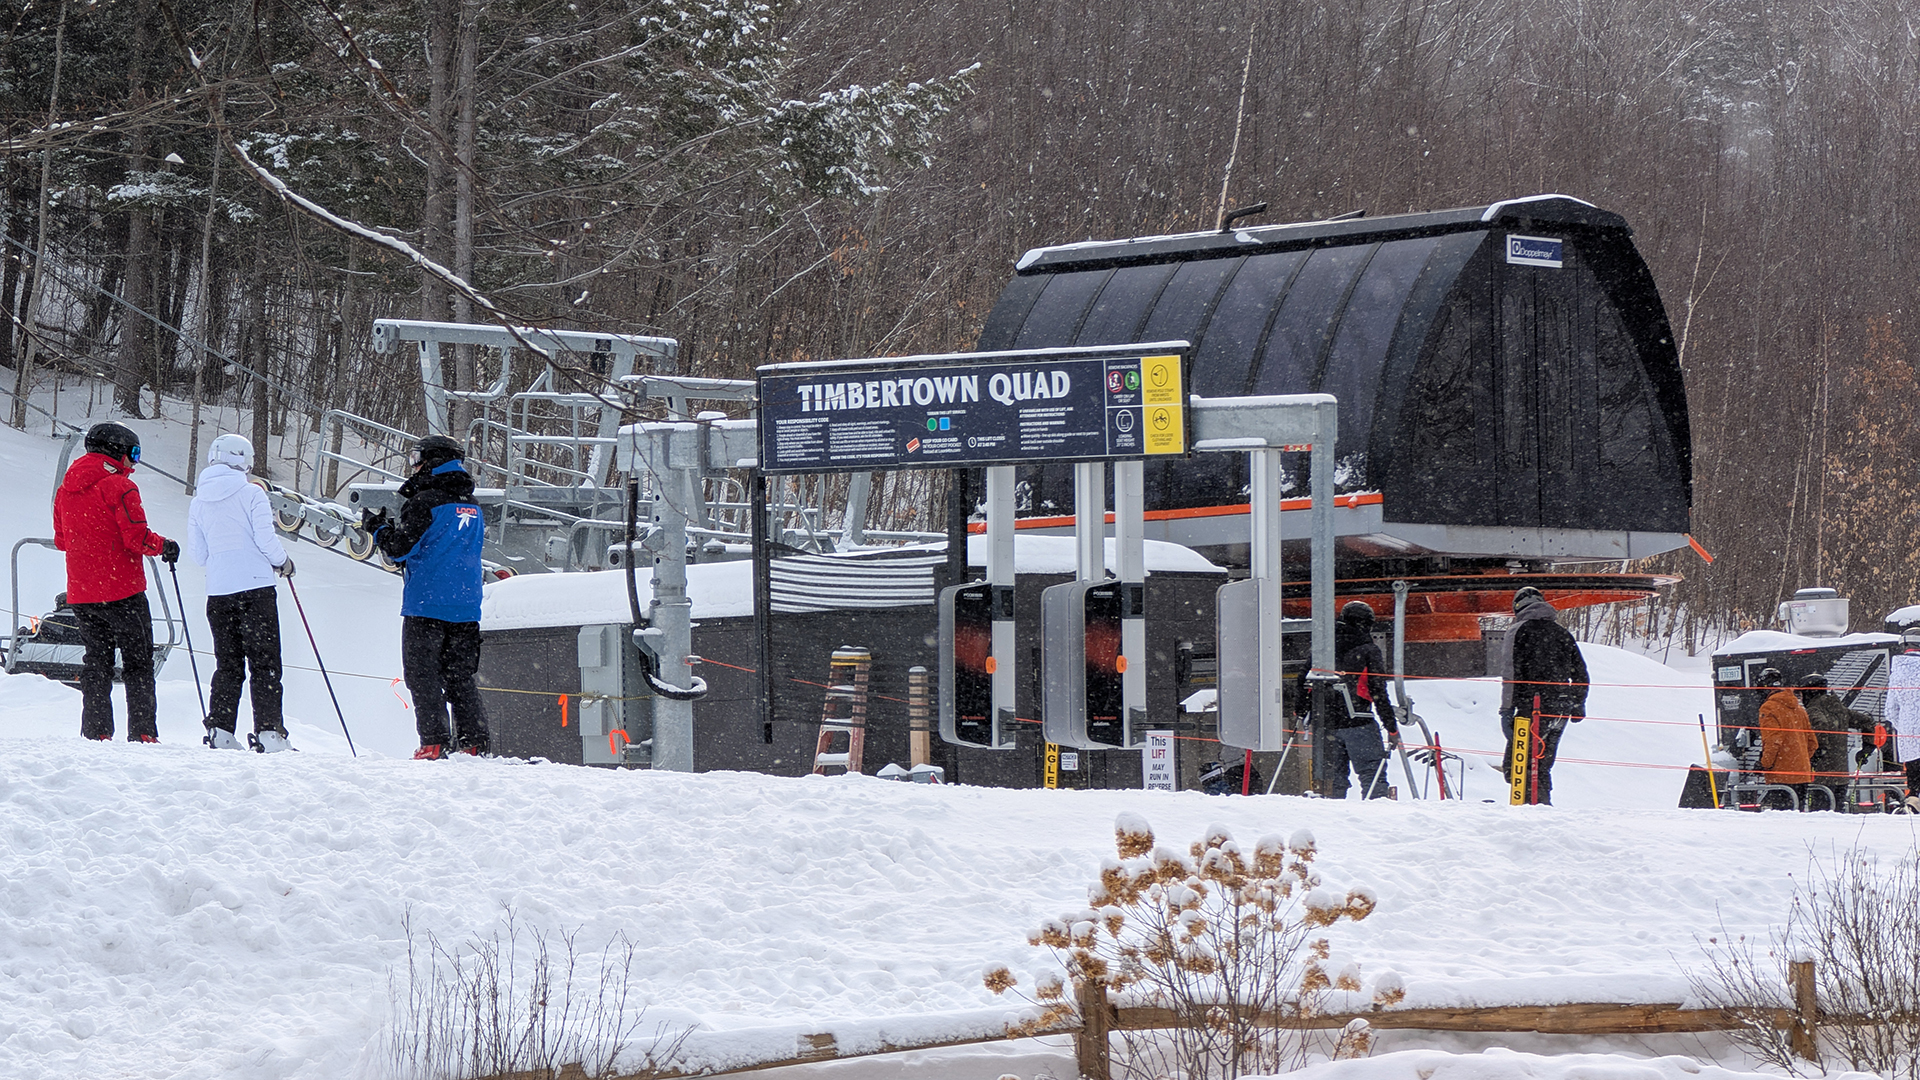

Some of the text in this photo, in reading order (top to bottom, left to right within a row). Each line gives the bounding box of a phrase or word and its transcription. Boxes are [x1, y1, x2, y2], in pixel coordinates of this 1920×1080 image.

[797, 370, 1071, 411] TIMBERTOWN QUAD
[1151, 737, 1166, 746] This
[1152, 749, 1166, 759] LIFT
[1514, 728, 1526, 800] GROUPS
